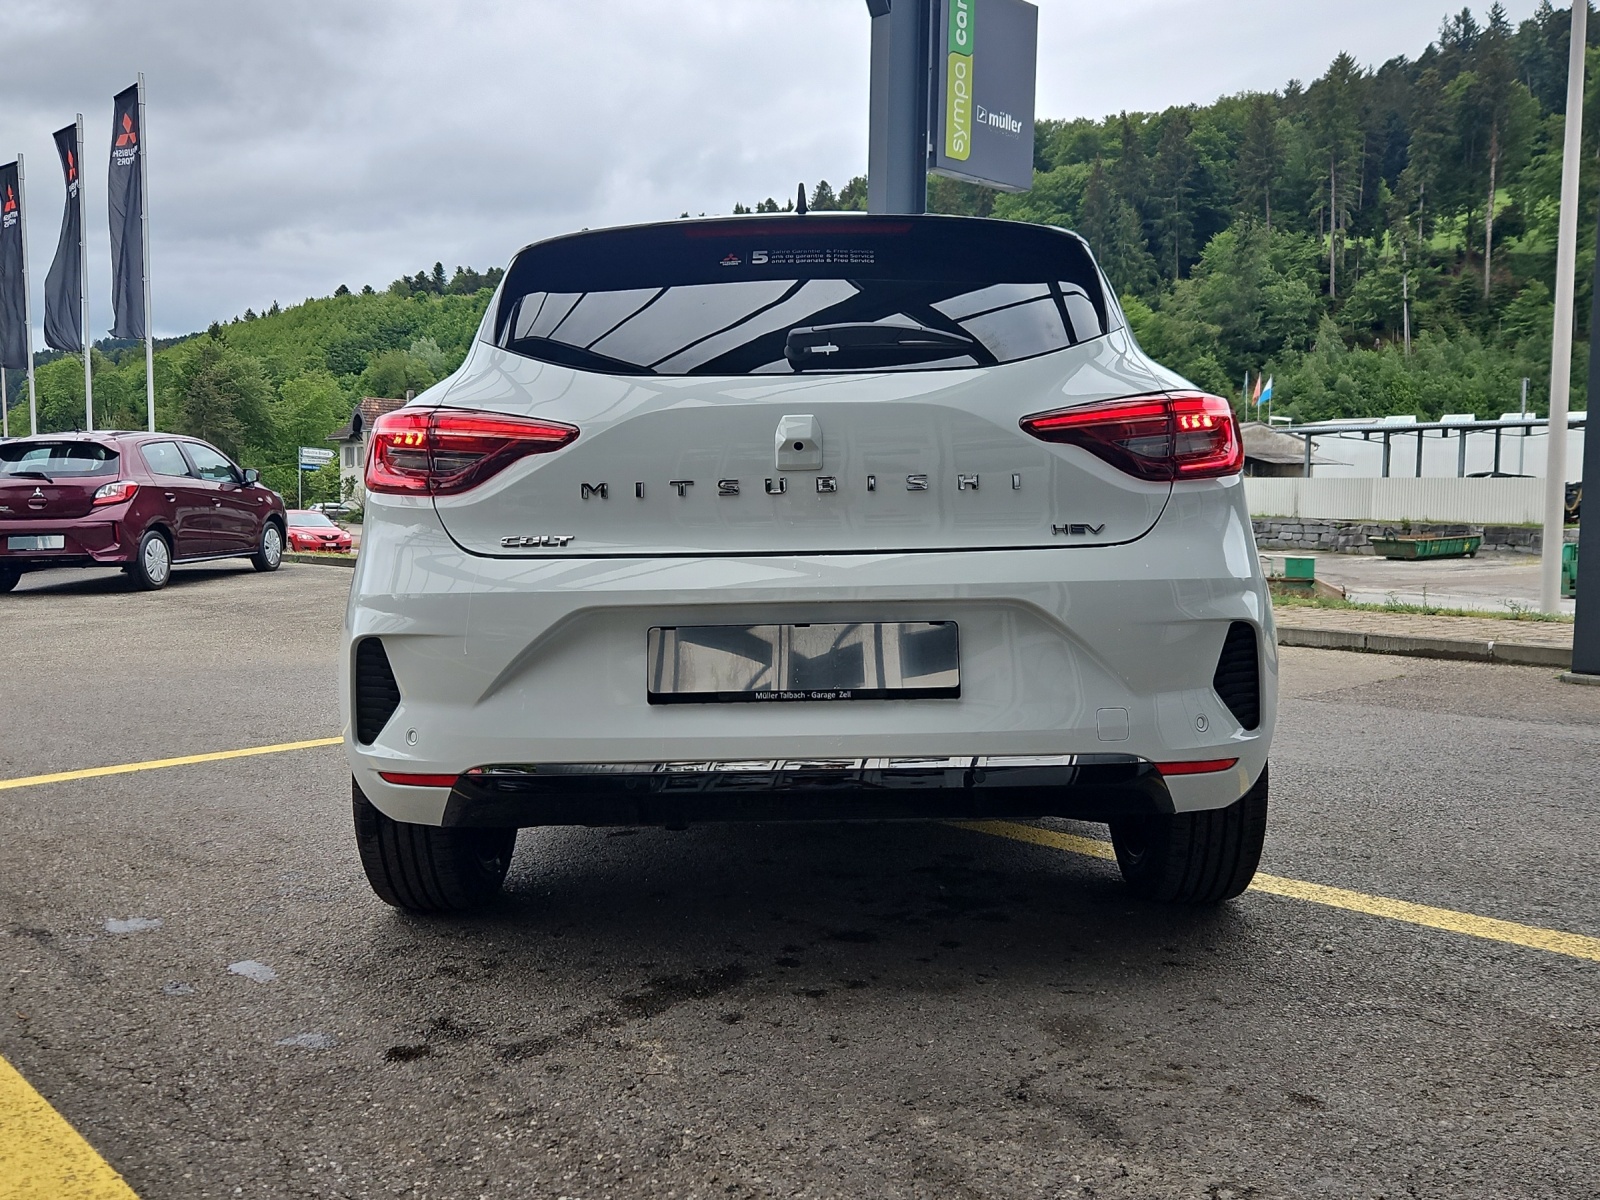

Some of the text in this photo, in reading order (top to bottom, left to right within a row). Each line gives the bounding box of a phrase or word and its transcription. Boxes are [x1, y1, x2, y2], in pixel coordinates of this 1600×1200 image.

[953, 62, 968, 153] sympa
[988, 111, 1022, 133] müller
[751, 250, 769, 264] 5
[581, 474, 1022, 500] MITSUBISHI
[1051, 523, 1105, 536] HEV
[500, 535, 575, 548] COLT
[755, 692, 778, 700] Müller
[780, 691, 805, 699] Talbach
[811, 691, 836, 700] Garage
